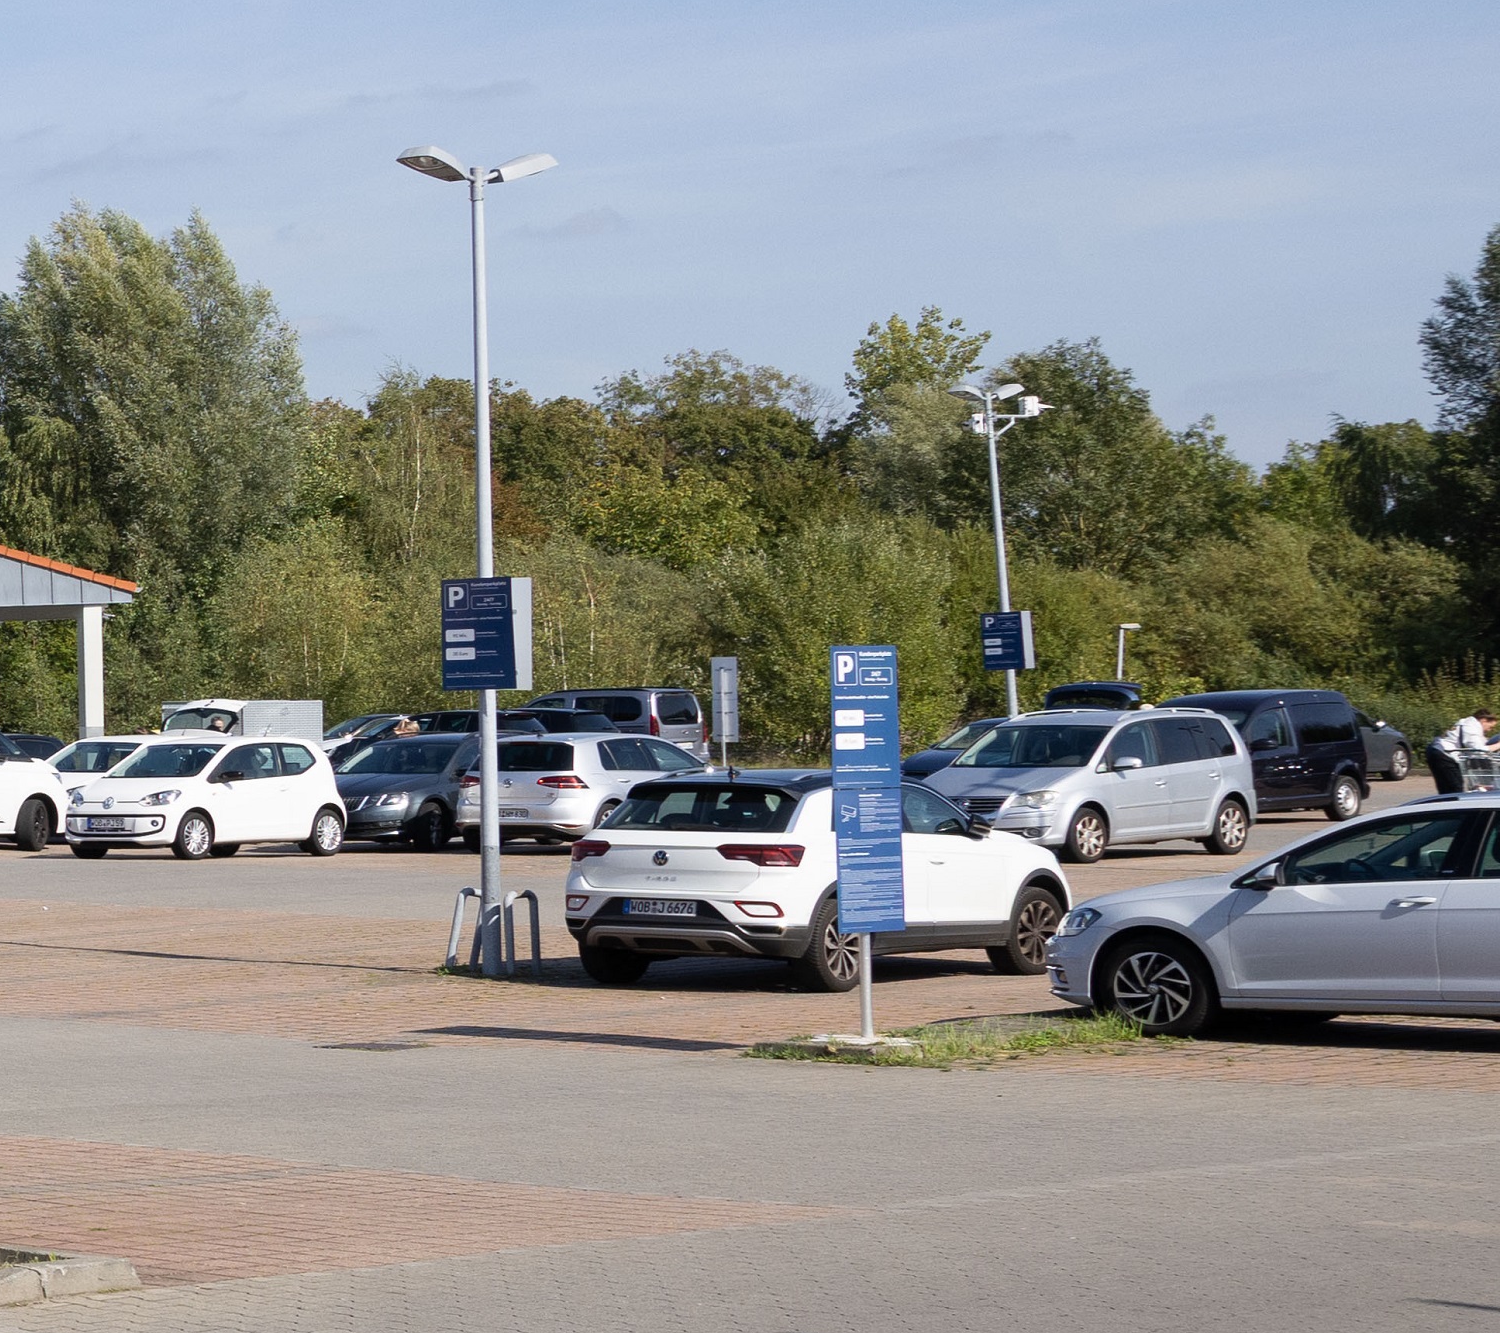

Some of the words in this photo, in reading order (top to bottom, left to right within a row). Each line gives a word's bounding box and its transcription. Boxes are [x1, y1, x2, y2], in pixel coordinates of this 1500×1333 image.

[448, 586, 465, 608] P
[984, 616, 995, 628] P
[837, 654, 854, 682] P
[630, 900, 651, 913] WOB
